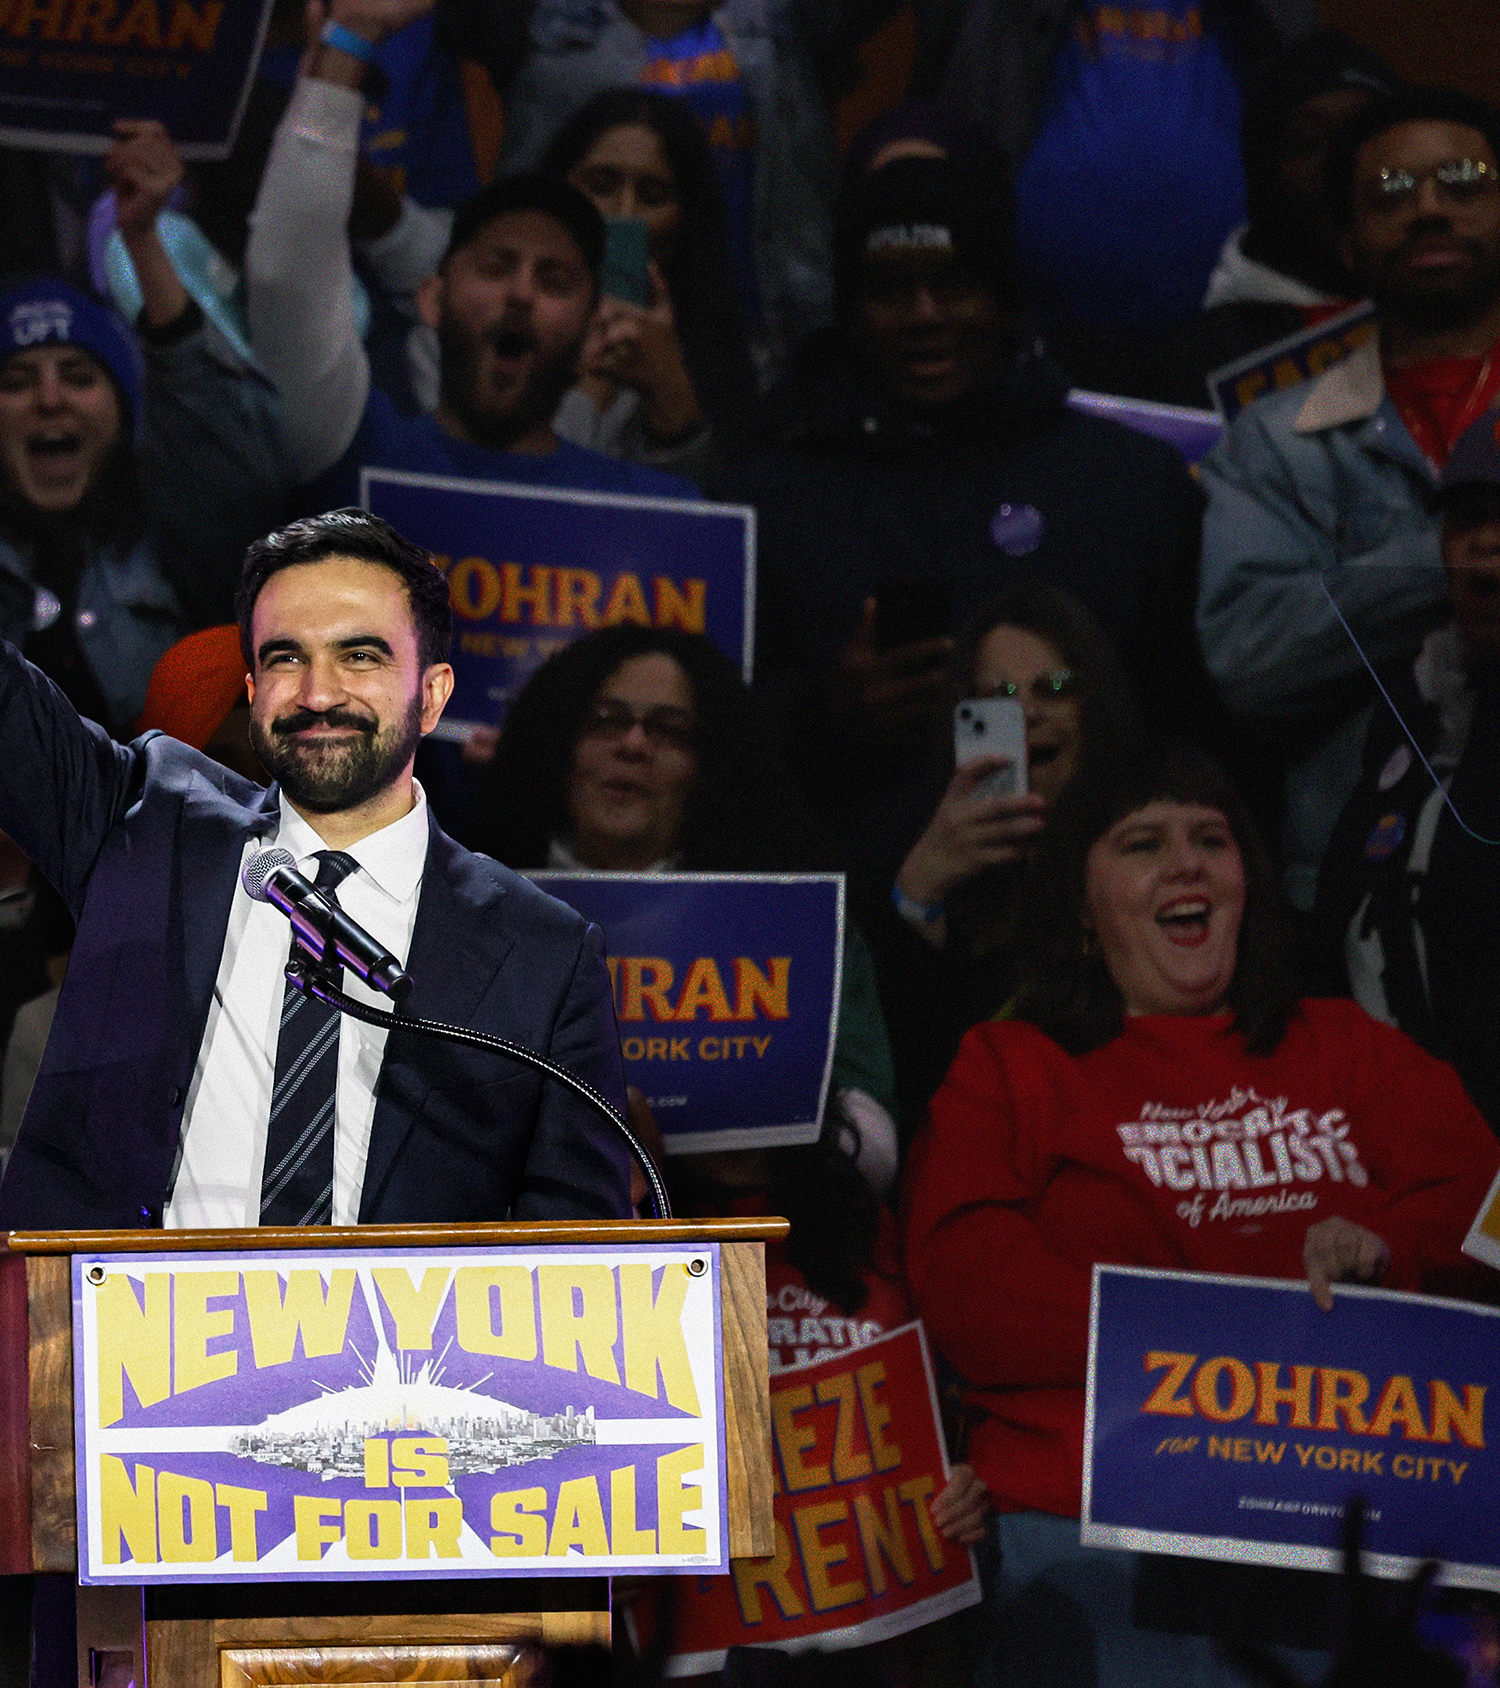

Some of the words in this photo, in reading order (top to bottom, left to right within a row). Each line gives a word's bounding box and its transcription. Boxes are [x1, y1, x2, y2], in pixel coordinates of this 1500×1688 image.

[436, 553, 708, 636] OHRAN
[458, 630, 531, 659] NEW
[605, 955, 793, 1025] RAN
[697, 1032, 773, 1062] CITY
[1174, 1191, 1206, 1229] of
[1207, 1187, 1320, 1222] America
[96, 1268, 357, 1429] NEW
[370, 1263, 702, 1418] YORK
[771, 1360, 902, 1496] EZE
[1139, 1349, 1489, 1451] ZOHRAN
[364, 1437, 449, 1488] IS
[1206, 1435, 1288, 1465] NEW
[1293, 1443, 1386, 1476] YORK
[1390, 1452, 1470, 1486] CITY
[100, 1453, 268, 1564] NOT
[293, 1497, 463, 1561] FOR
[490, 1442, 708, 1558] SALE
[730, 1473, 944, 1628] RENT
